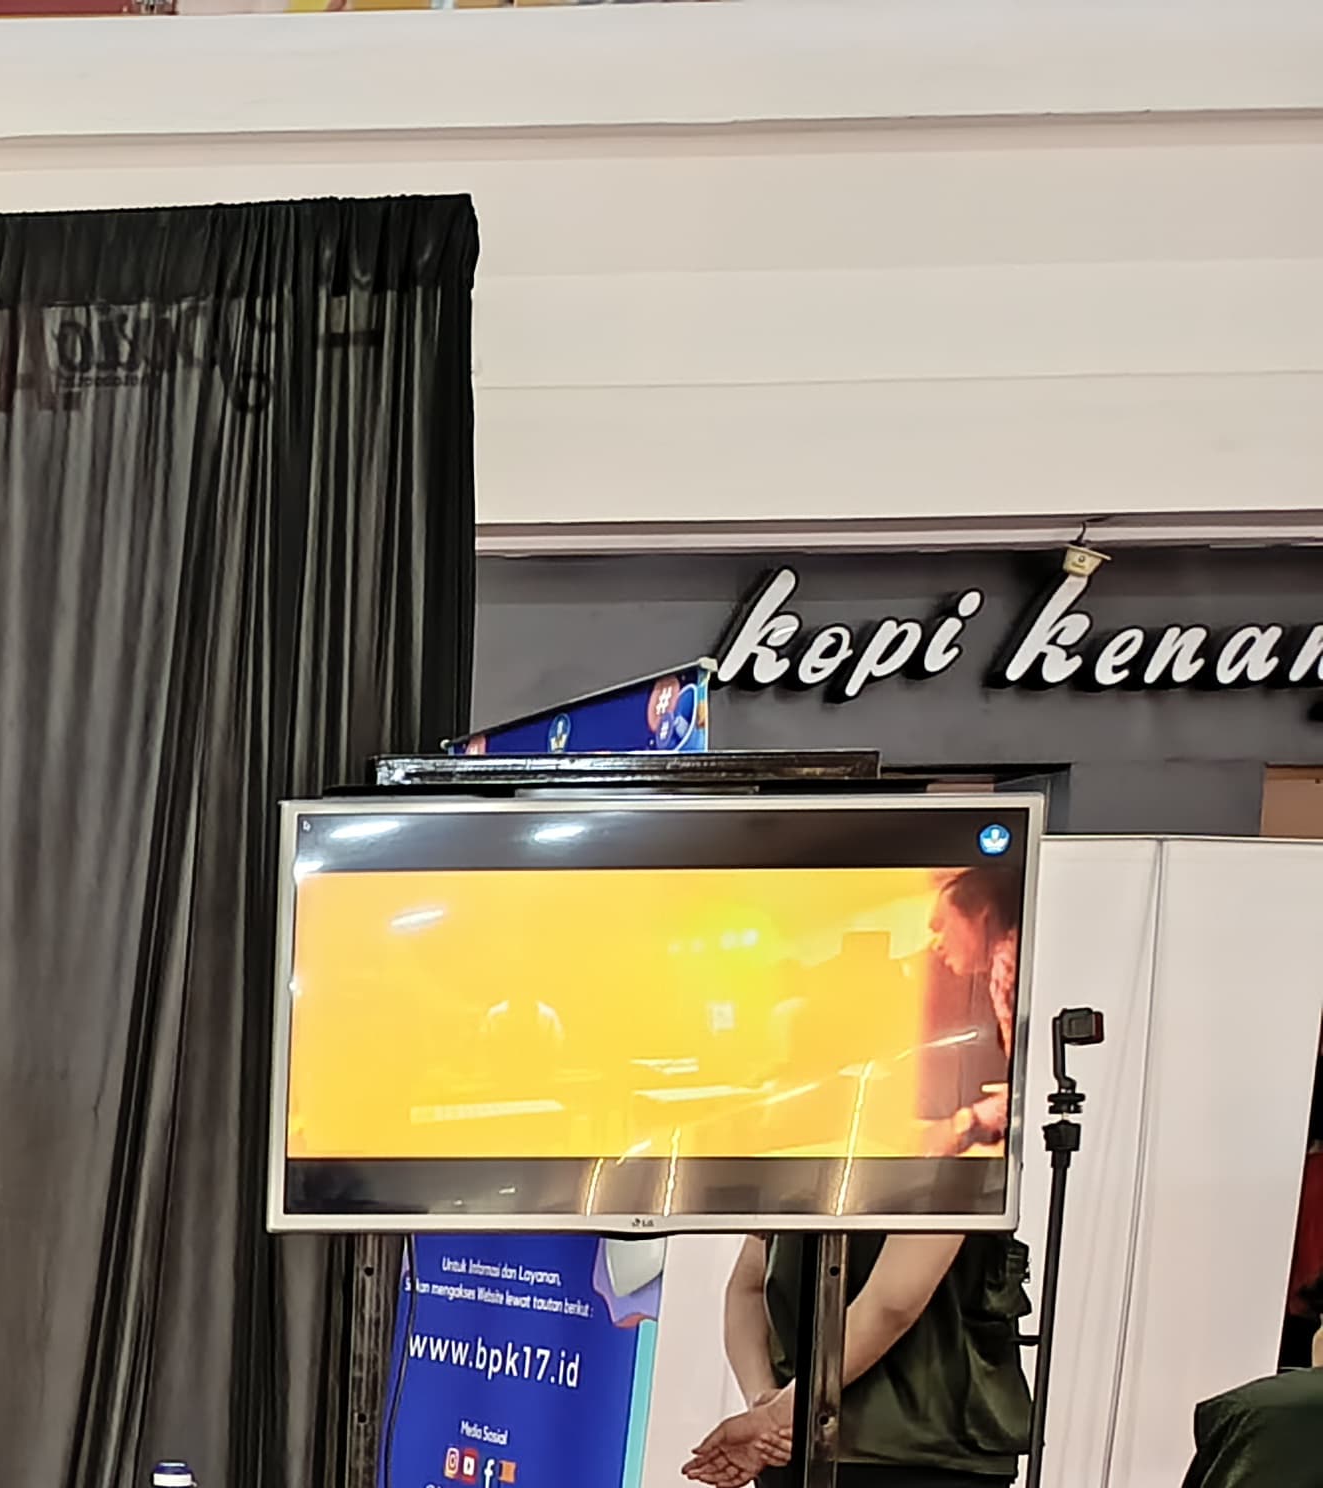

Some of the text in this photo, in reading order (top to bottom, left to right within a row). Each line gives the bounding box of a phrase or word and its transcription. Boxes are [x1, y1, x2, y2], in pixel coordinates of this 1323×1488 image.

[715, 566, 983, 698] kopi
[501, 1262, 517, 1280] dan
[409, 1332, 581, 1389] www.bpk17.id
